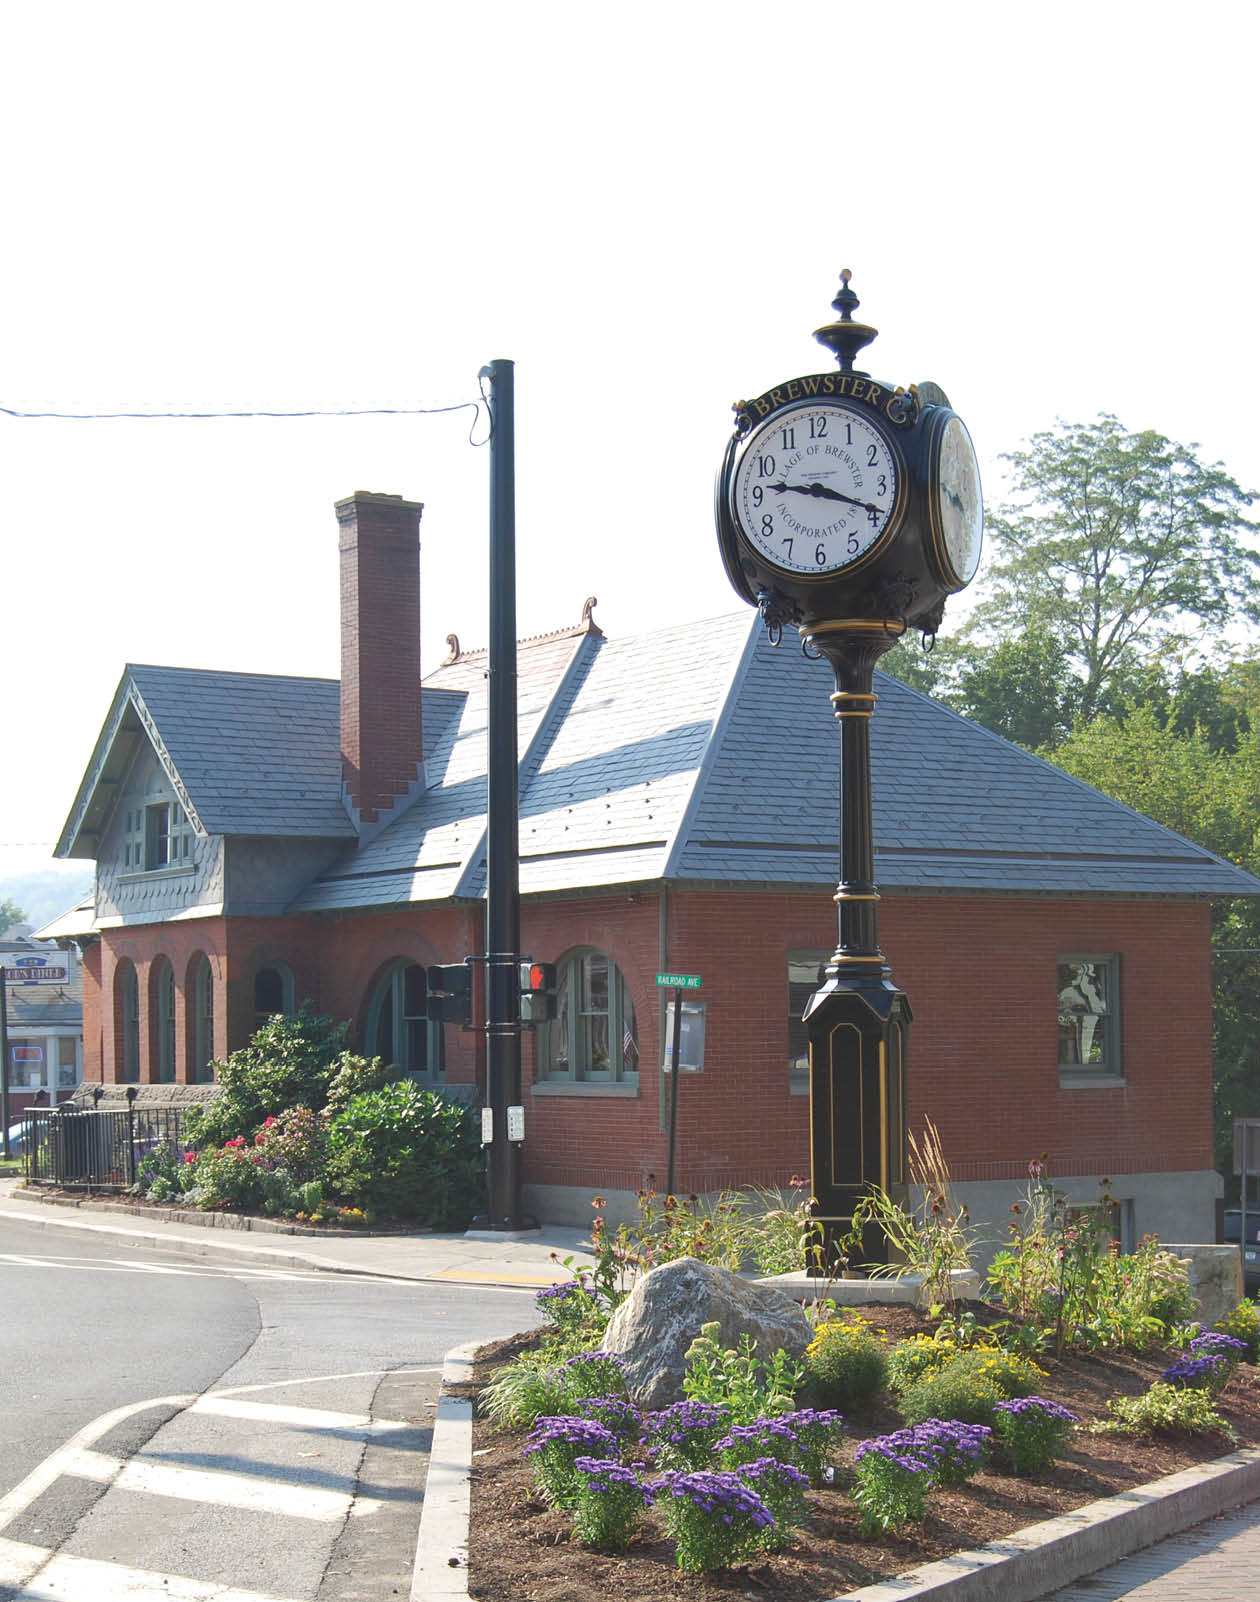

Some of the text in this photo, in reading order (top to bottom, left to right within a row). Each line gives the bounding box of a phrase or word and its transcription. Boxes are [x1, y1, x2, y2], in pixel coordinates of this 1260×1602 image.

[754, 376, 881, 417] BREWSTER
[809, 416, 828, 438] 12
[845, 423, 853, 445] 1
[781, 428, 796, 449] 11
[758, 455, 775, 477] 10
[866, 444, 879, 466] 2
[806, 445, 820, 456] OF
[825, 444, 863, 489] BREWSTER
[752, 485, 763, 507] 9
[877, 475, 887, 496] 3
[761, 514, 774, 536] 8
[776, 503, 847, 538] INCORPORATED
[867, 508, 880, 527] 4
[781, 538, 793, 560] 7
[847, 530, 859, 554] 5
[815, 544, 826, 566] 6
[658, 976, 698, 987] RAILROAD AVE
